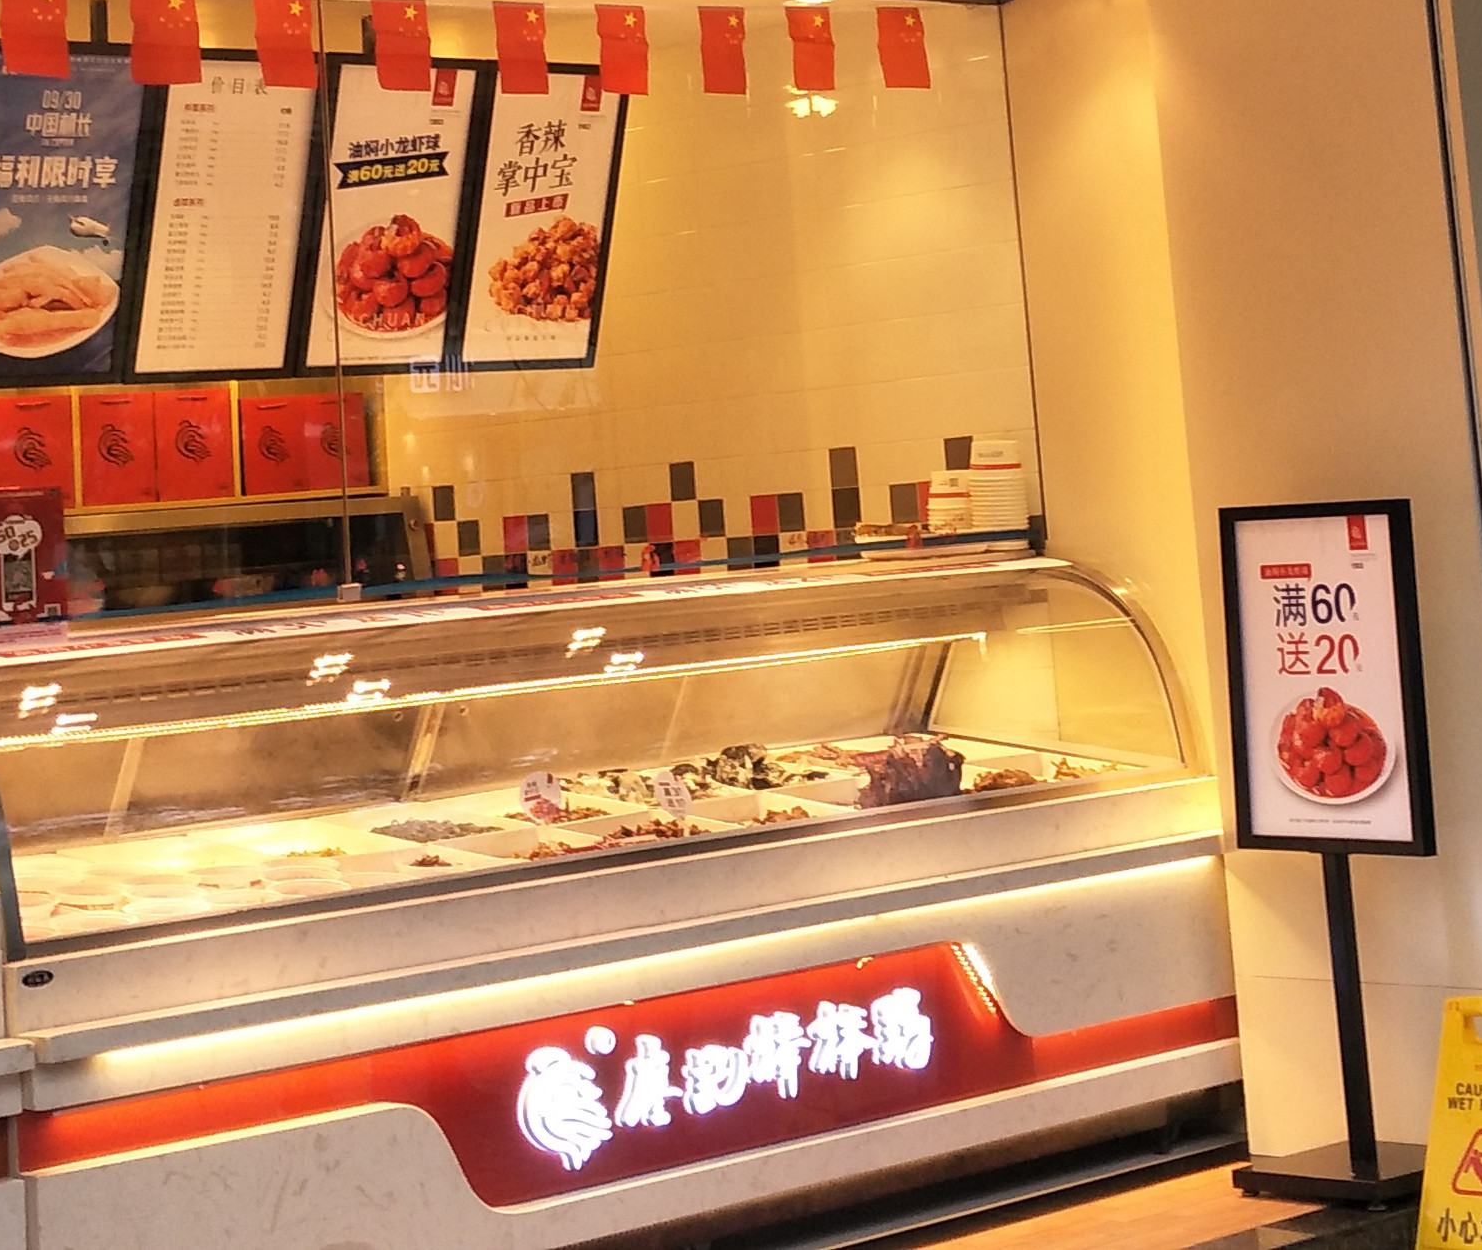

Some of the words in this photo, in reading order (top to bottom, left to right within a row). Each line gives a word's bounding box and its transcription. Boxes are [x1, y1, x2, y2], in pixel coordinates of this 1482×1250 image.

[42, 89, 82, 110] 09/30
[348, 133, 441, 160] 油焖小龙虾球
[516, 119, 568, 157] 香辣
[347, 159, 440, 184] 满60元送20元
[494, 153, 578, 197] 掌中宝
[1447, 1097, 1474, 1111] WET
